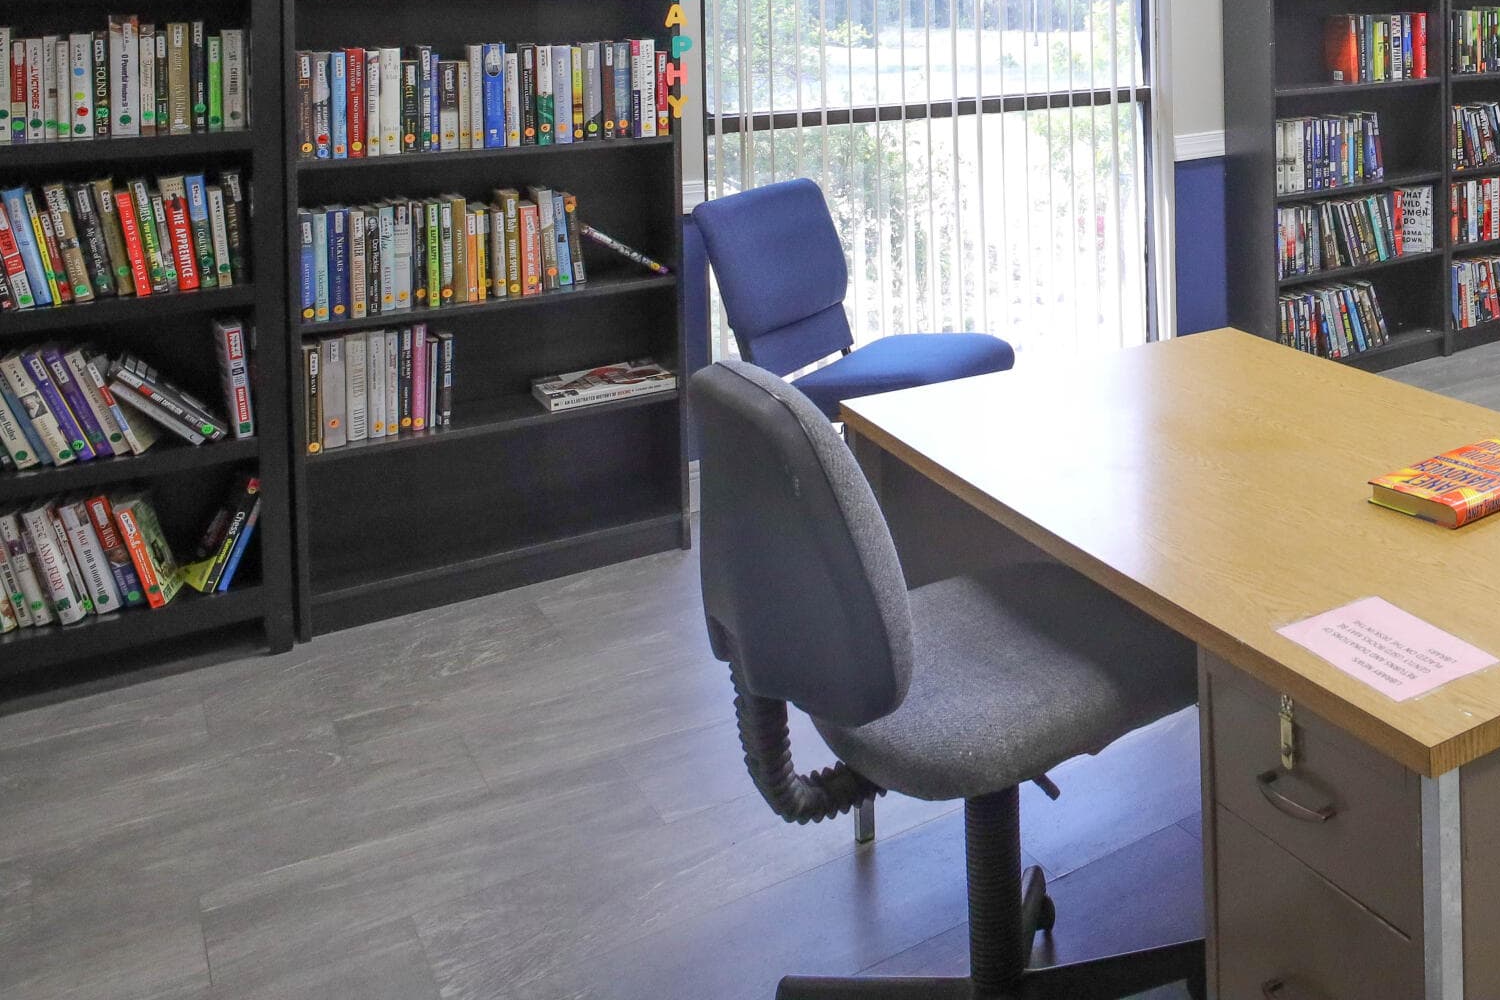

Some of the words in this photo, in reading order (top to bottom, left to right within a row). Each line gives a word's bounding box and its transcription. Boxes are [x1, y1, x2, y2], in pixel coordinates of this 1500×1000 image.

[96, 67, 106, 96] FOUND
[31, 74, 39, 109] VICTORIES
[46, 190, 65, 237] HAPPENED
[173, 208, 185, 224] THE
[86, 228, 94, 237] My
[88, 238, 99, 253] Share
[125, 219, 136, 241] BOYS
[134, 259, 145, 281] BOAT
[175, 228, 193, 278] APPRENTICE
[336, 236, 345, 272] NICKLAUS
[94, 259, 103, 268] the
[1399, 473, 1465, 495] JANET
[228, 510, 245, 536] Chess
[216, 538, 233, 564] dummies
[40, 542, 55, 564] AND
[48, 567, 64, 592] FURY
[76, 530, 88, 547] RAGE
[83, 549, 94, 563] BOB
[90, 563, 106, 595] WOODWAR
[1351, 620, 1365, 628] THE
[1332, 632, 1371, 655] DONATIONS
[1362, 636, 1386, 652] BOOKS
[1390, 640, 1405, 650] THE
[1405, 647, 1418, 655] ON
[1369, 652, 1385, 663] AND
[1383, 649, 1404, 660] USED
[1415, 653, 1443, 669] PLACED
[1426, 648, 1457, 664] LIBRARY
[1385, 660, 1418, 680] RETURNS
[1403, 658, 1432, 674] GENTLY
[1372, 669, 1402, 686] LIBRARY
